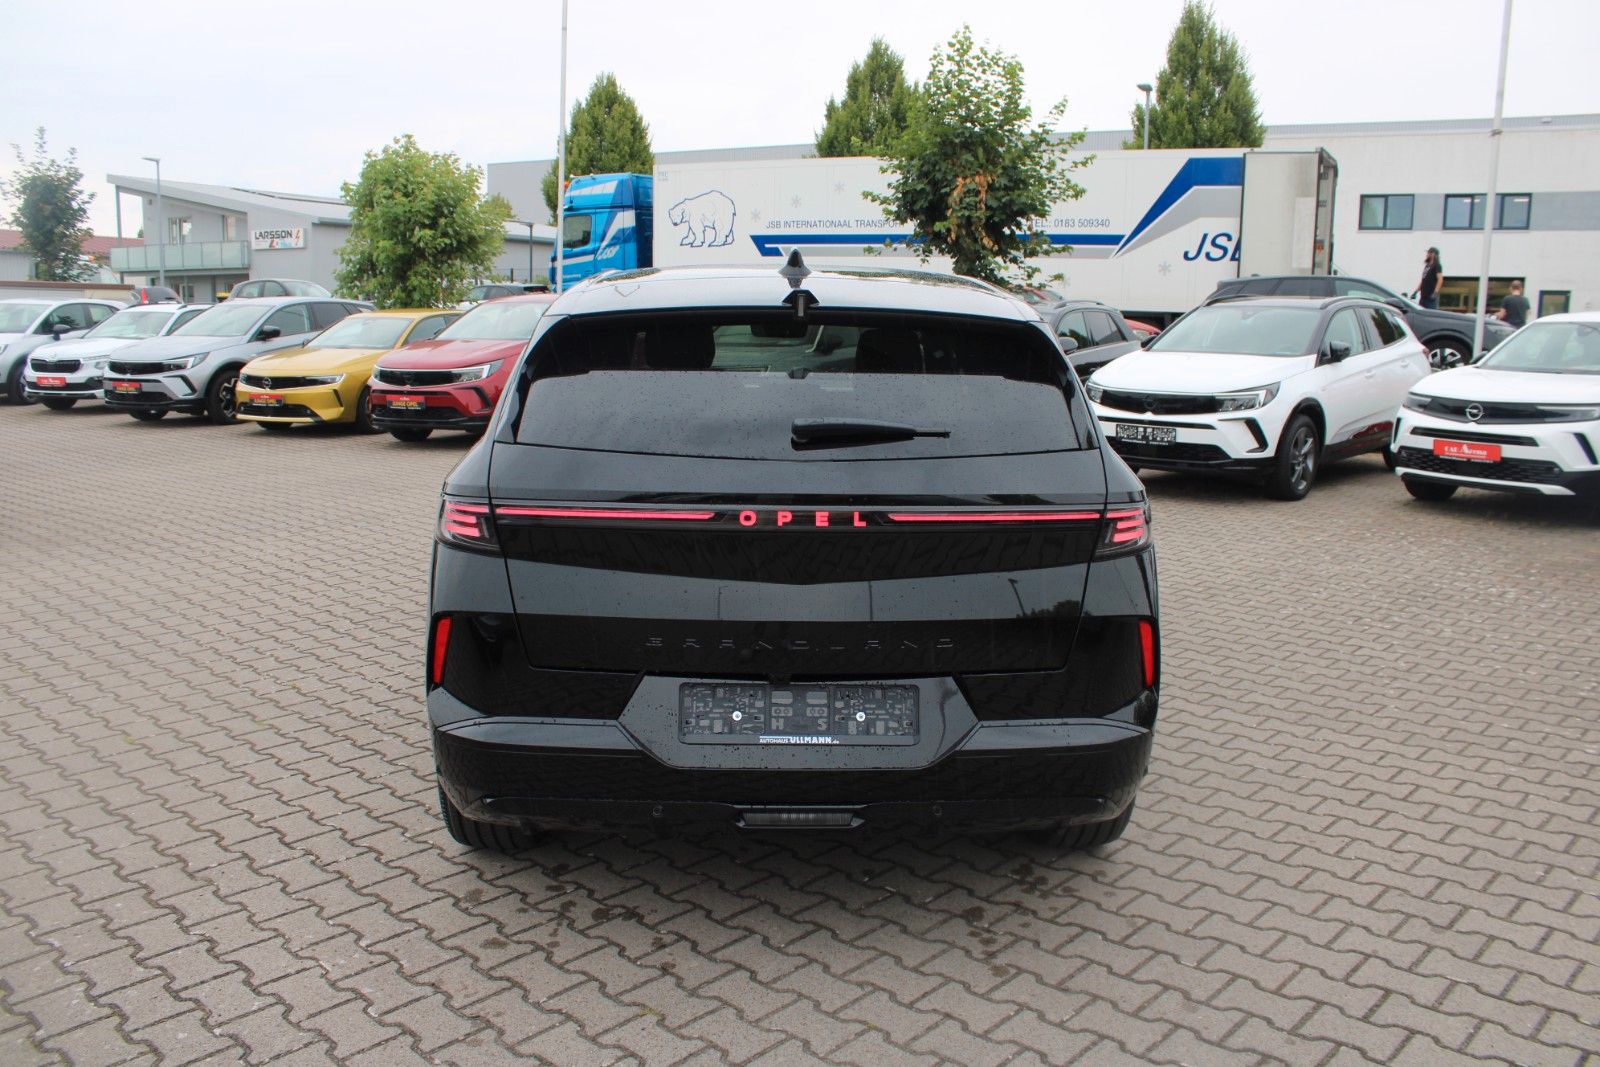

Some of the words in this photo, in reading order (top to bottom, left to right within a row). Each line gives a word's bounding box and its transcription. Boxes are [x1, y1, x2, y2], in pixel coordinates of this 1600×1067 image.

[783, 219, 853, 229] INTERNATIONAAL
[1053, 218, 1076, 228] 0183
[1078, 218, 1111, 228] 509340
[254, 230, 293, 240] LARSSON
[738, 510, 868, 528] OPEL
